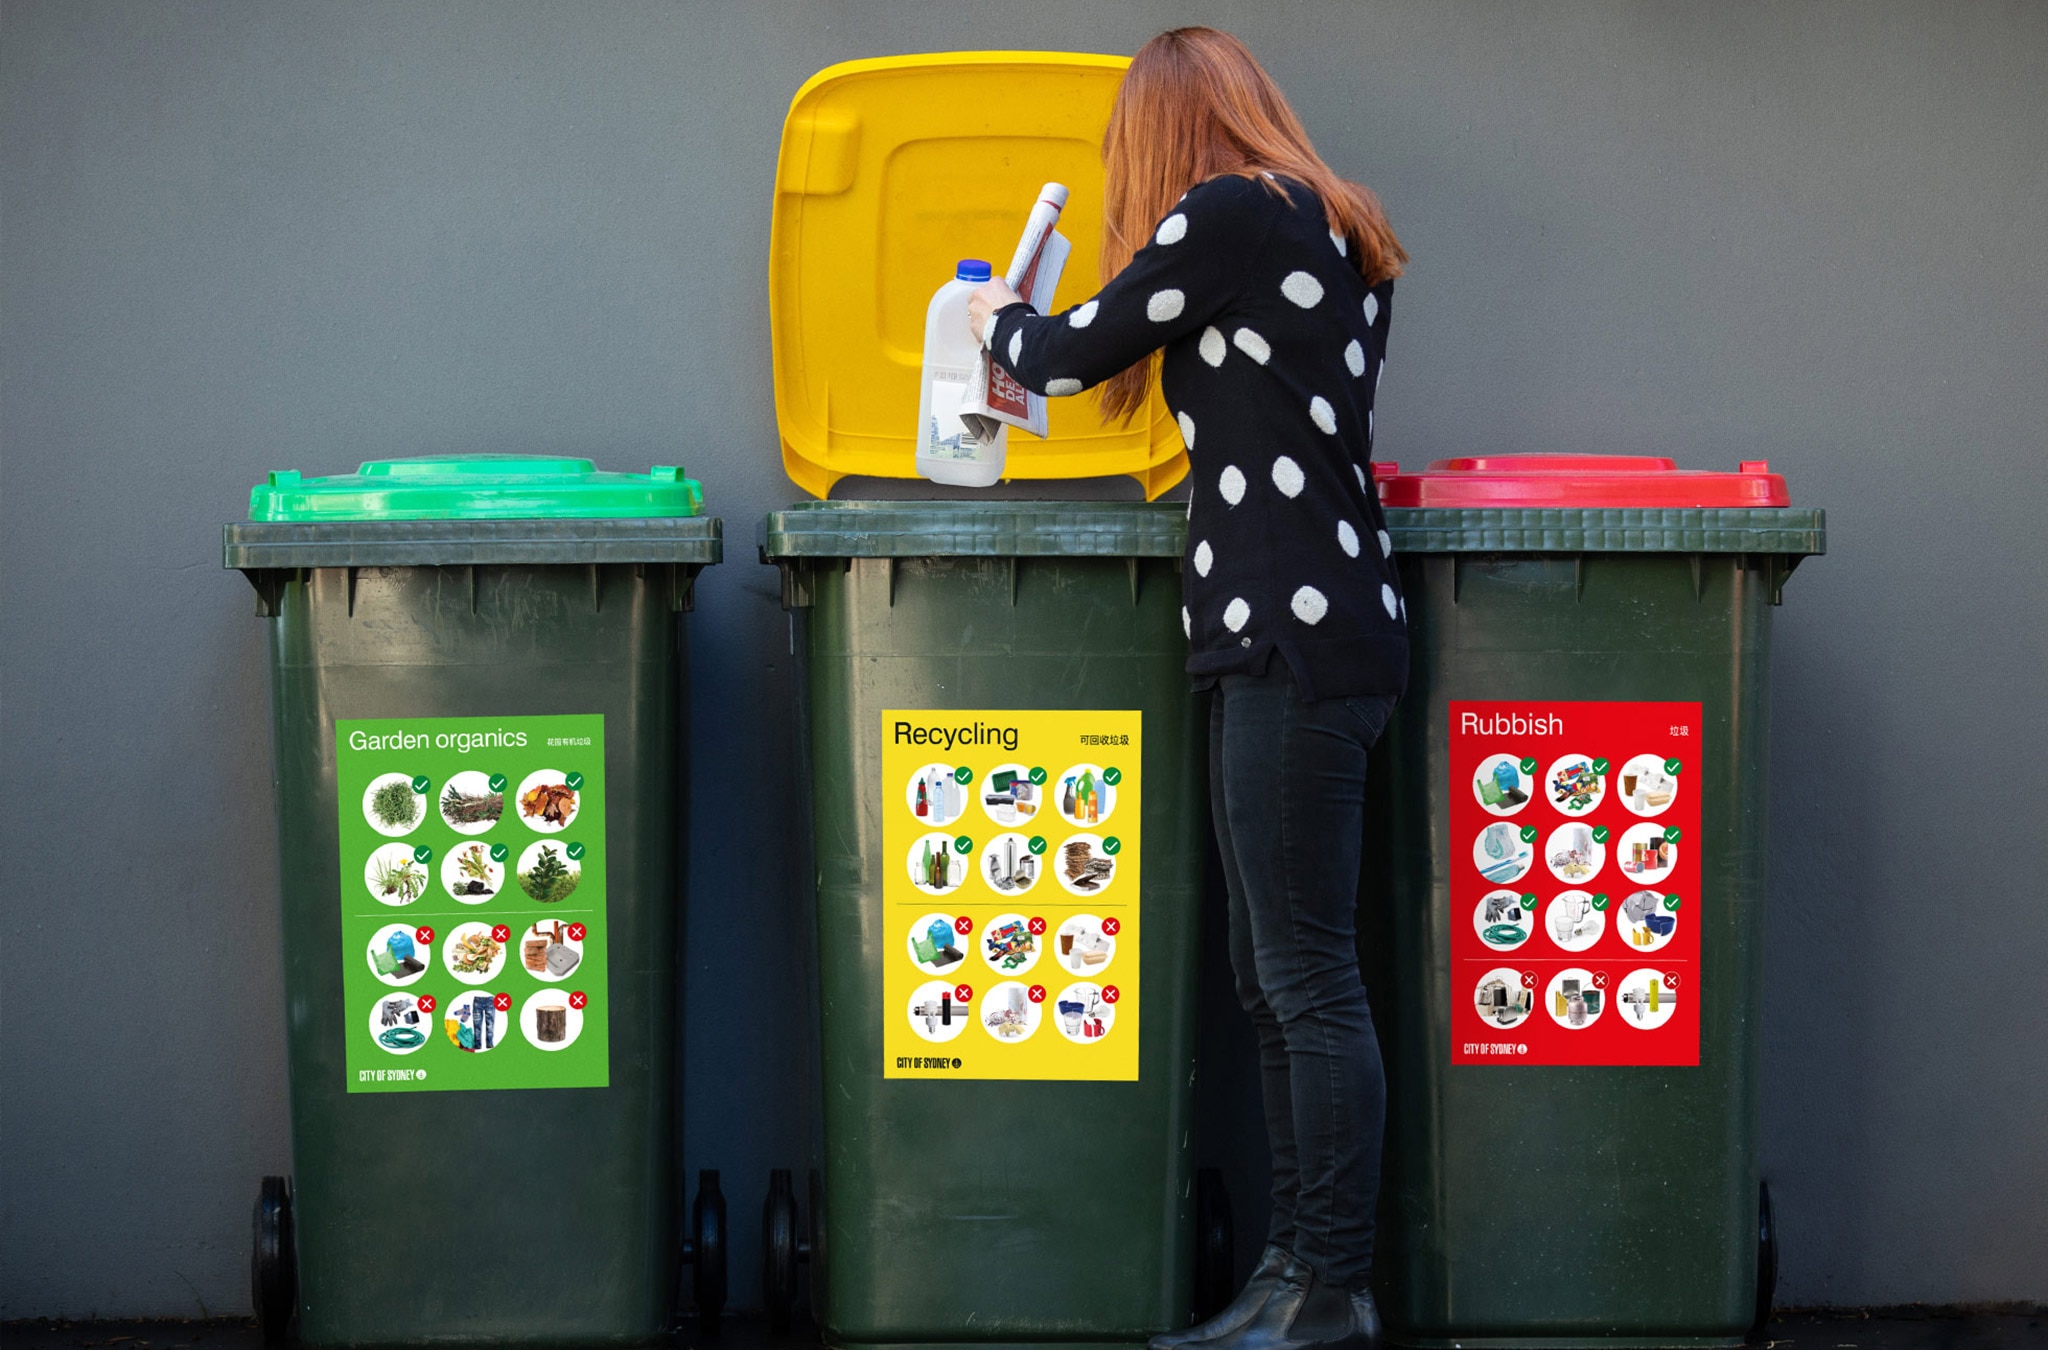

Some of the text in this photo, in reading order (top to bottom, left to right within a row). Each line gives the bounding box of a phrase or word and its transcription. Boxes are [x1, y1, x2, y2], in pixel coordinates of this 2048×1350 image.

[1005, 373, 1016, 402] DE
[1015, 382, 1025, 406] AL
[1461, 712, 1563, 736] Rubbish
[1669, 725, 1689, 737] 垃圾
[349, 727, 528, 753] Garden organics
[895, 721, 1018, 751] Recycling
[1080, 734, 1130, 746] 可回收垃圾
[1463, 1043, 1516, 1055] CITY OF SYDNEY
[897, 1056, 950, 1069] CITY OF SYDNEY
[359, 1069, 415, 1082] CITY OF SYDNEY
